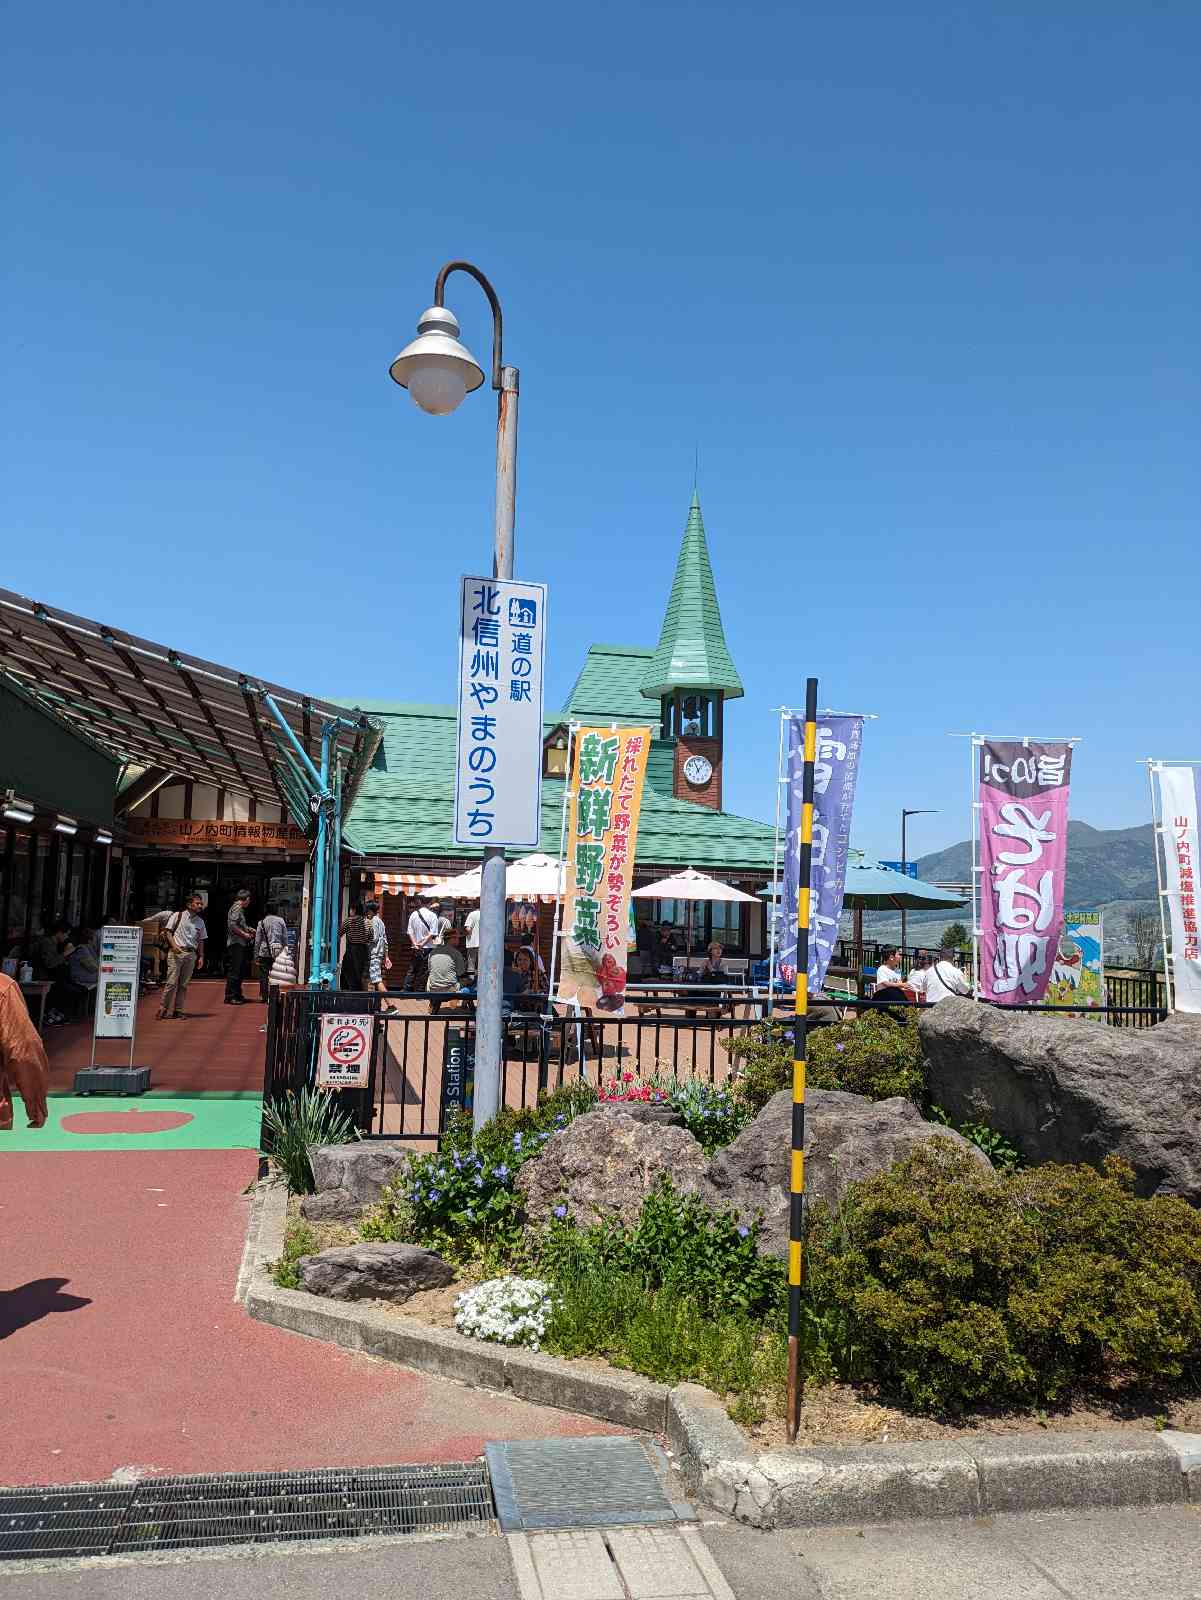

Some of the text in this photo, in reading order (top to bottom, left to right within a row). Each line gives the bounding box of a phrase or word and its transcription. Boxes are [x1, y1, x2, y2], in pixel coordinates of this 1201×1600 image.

[467, 584, 502, 838] 北信州やまのうち
[510, 632, 532, 702] 道の駅
[572, 732, 620, 951] 新鮮野菜
[604, 736, 644, 950] 採れたて野菜が勢ぞろい
[1174, 815, 1200, 960] 山ノ内町減塩推進協力店
[446, 1047, 461, 1096] Station
